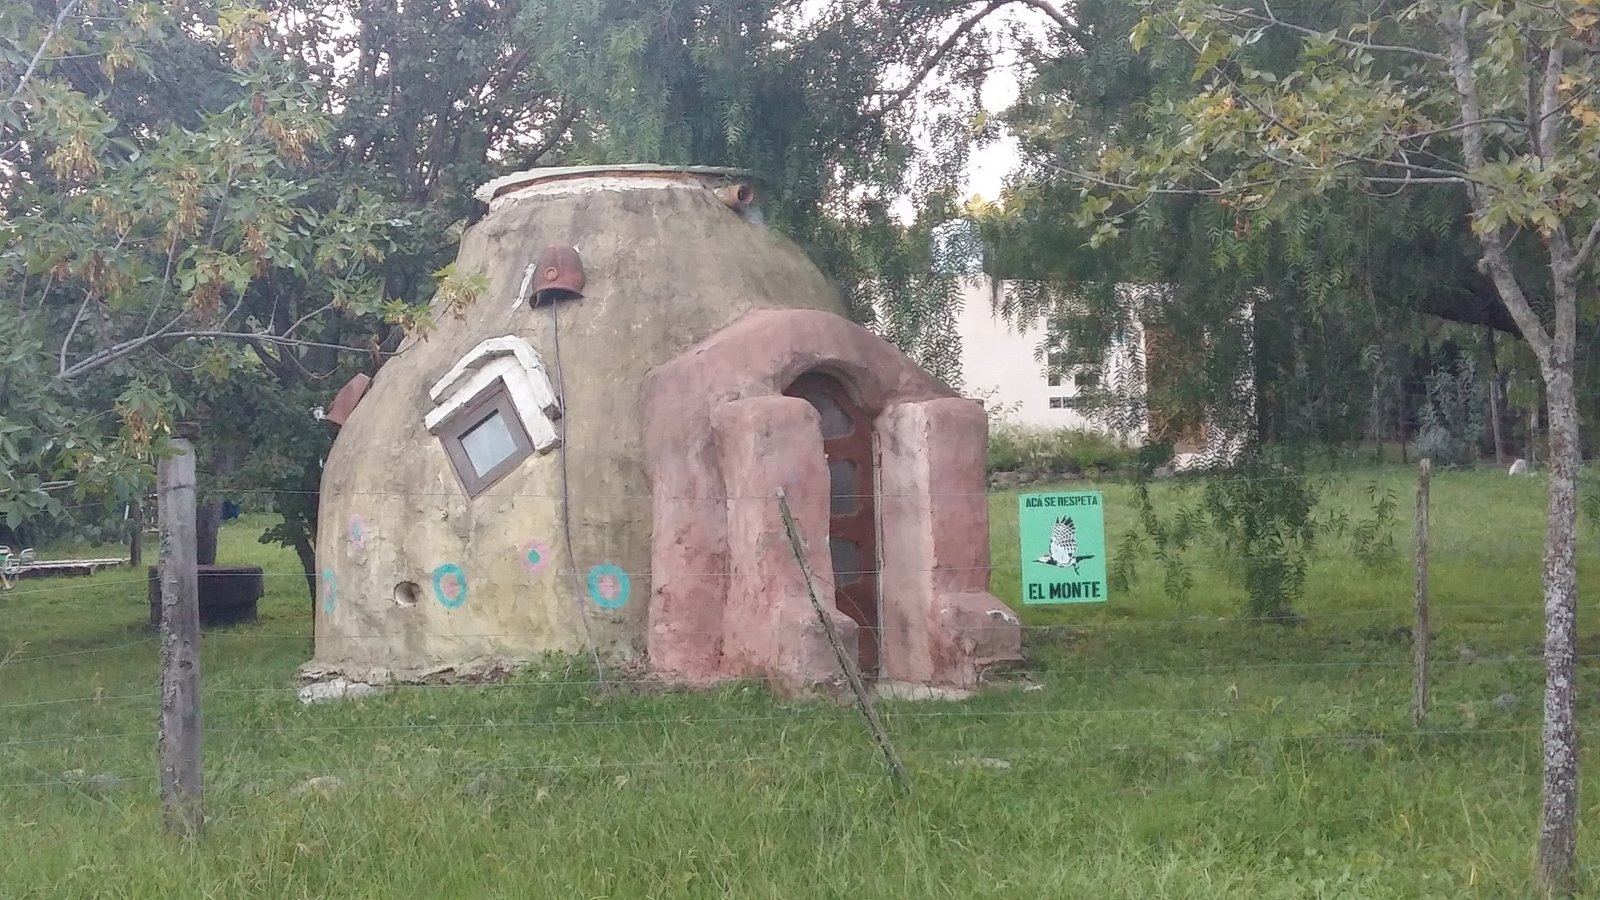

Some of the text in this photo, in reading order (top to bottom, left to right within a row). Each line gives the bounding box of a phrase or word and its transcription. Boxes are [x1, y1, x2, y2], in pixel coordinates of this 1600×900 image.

[1026, 494, 1098, 508] ACÁ SE RESPETA
[1028, 581, 1101, 600] EL MONTE
